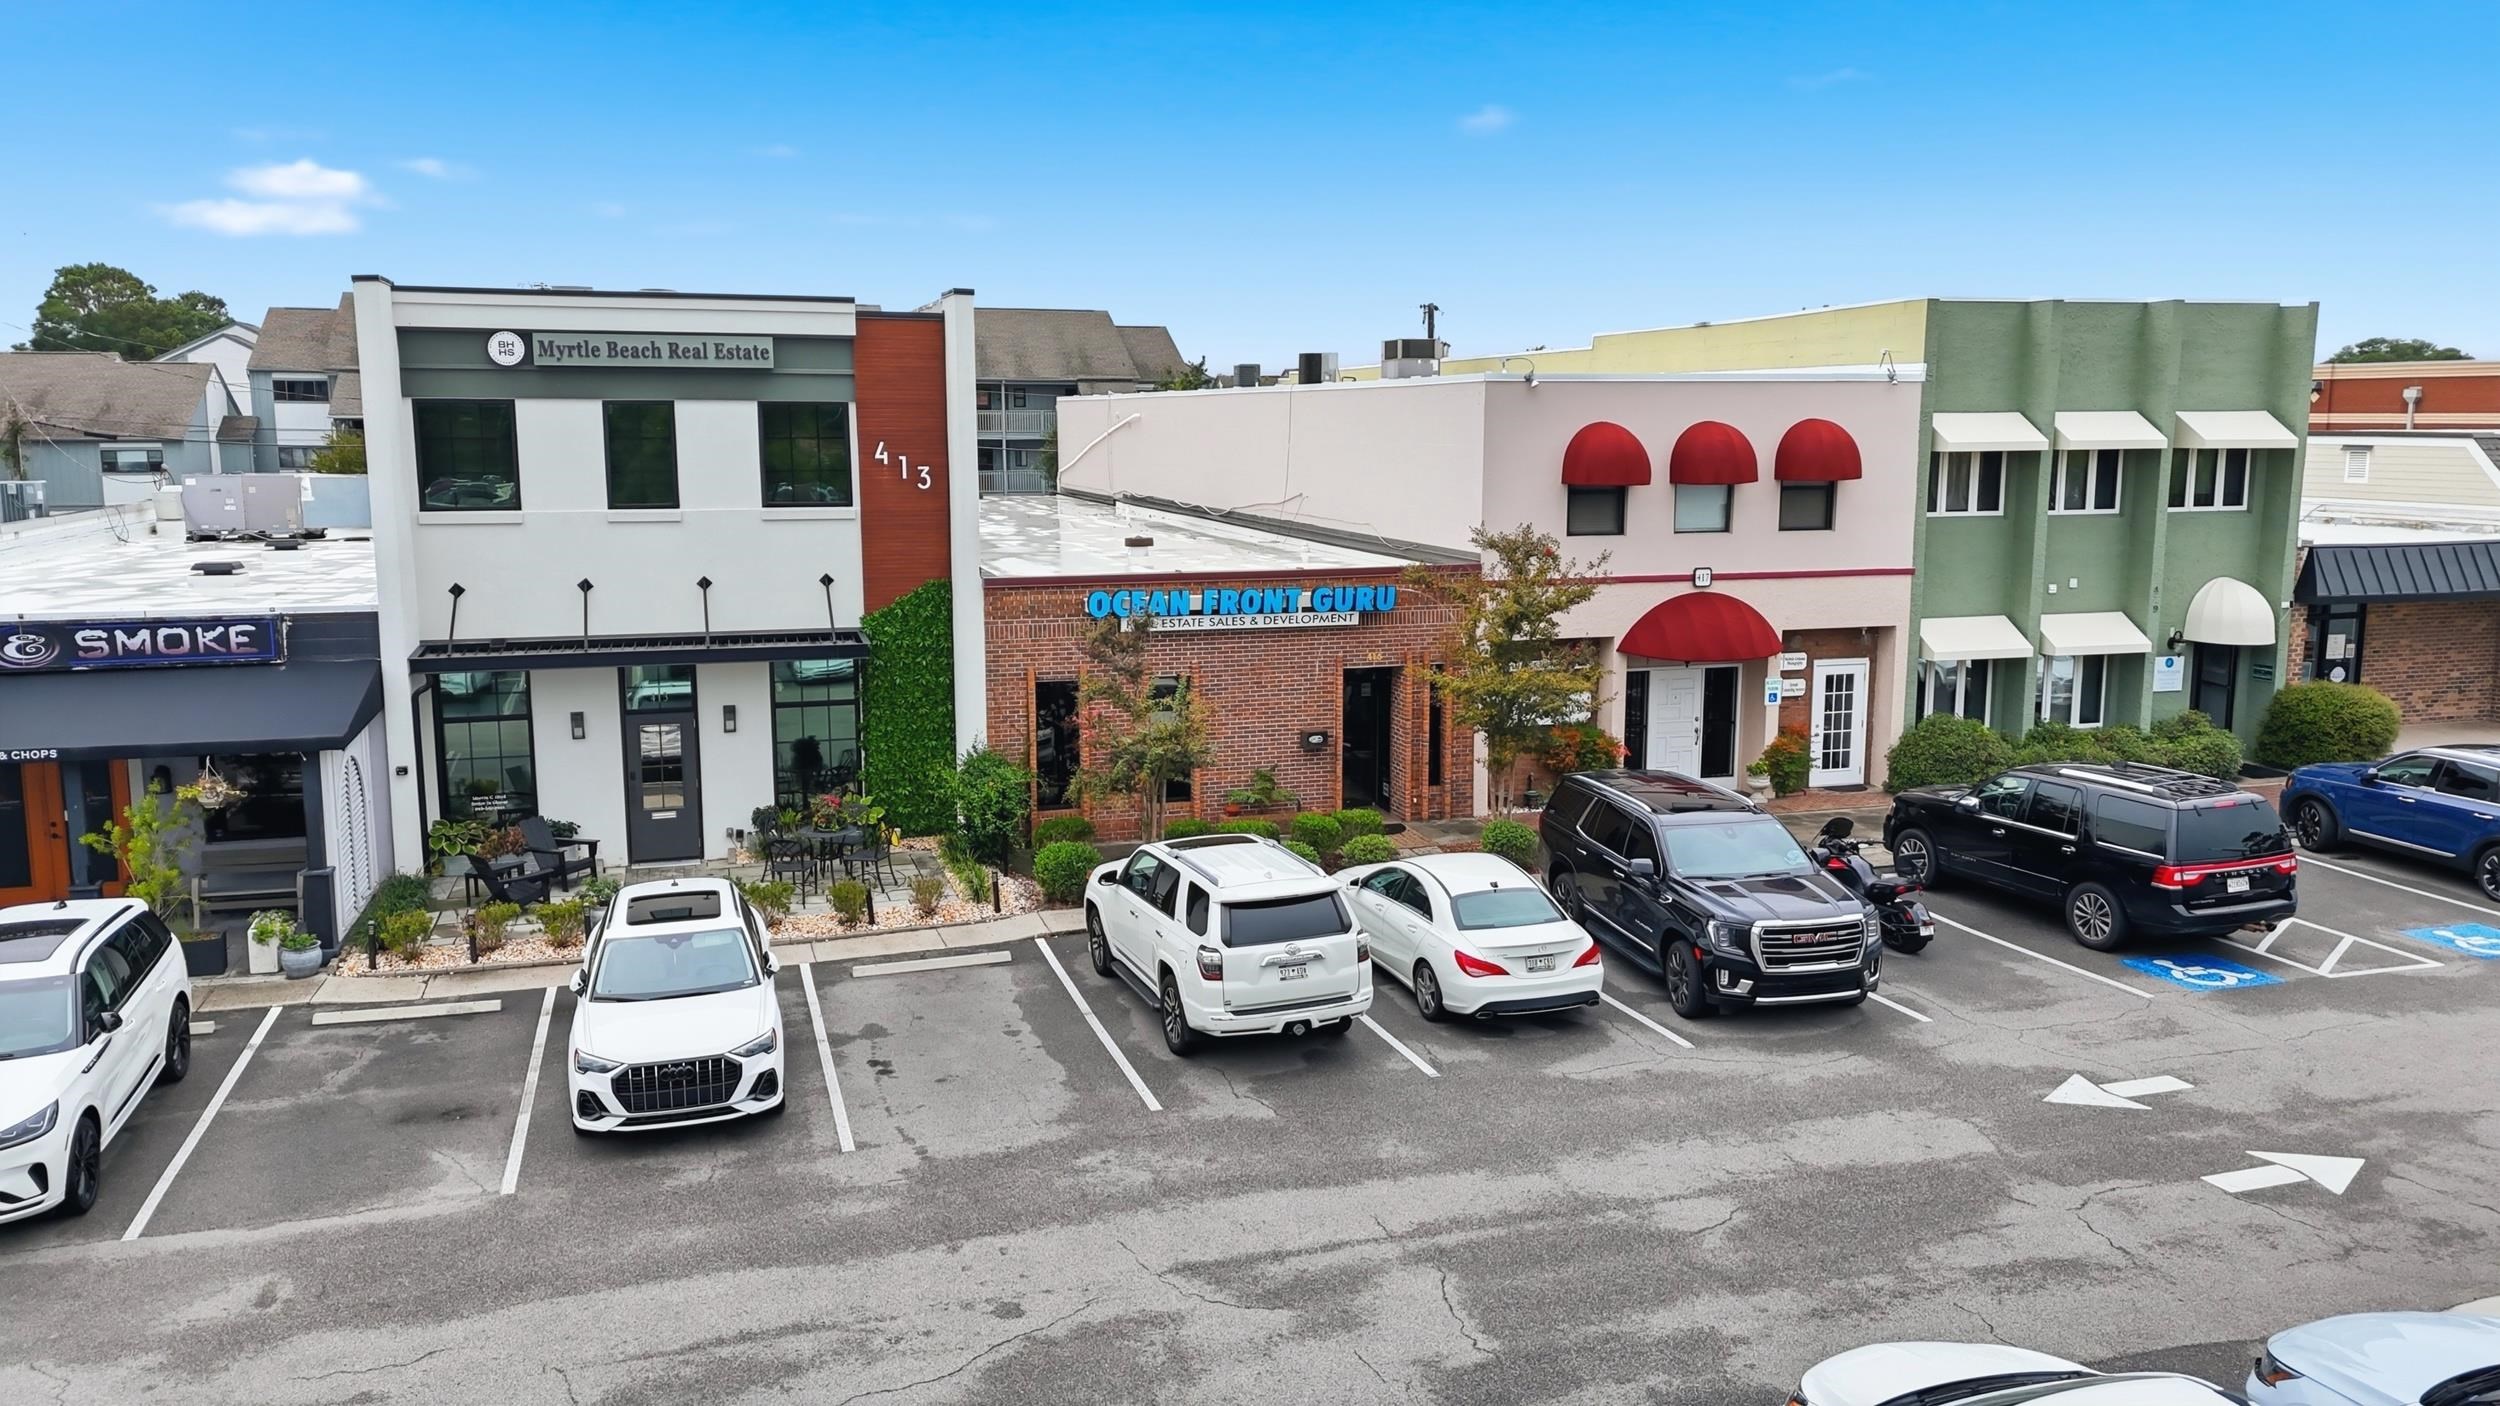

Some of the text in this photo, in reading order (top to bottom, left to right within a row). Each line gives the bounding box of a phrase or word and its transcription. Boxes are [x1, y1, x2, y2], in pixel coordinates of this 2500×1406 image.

[498, 340, 514, 348] BH
[538, 340, 770, 362] Myrtle Beach Real Estate
[498, 348, 515, 357] HS
[874, 441, 931, 490] 413
[1696, 573, 1710, 582] 417
[1088, 584, 1397, 619] OCEAN FRONT GURU
[1161, 616, 1205, 628] ESTATE
[1208, 615, 1246, 627] SALES
[1249, 616, 1259, 626] &
[1262, 612, 1356, 625] DEVELOPMENT
[3, 624, 259, 659] & SMOKE
[10, 749, 58, 760] CHOPS
[1793, 931, 1838, 944] GMC
